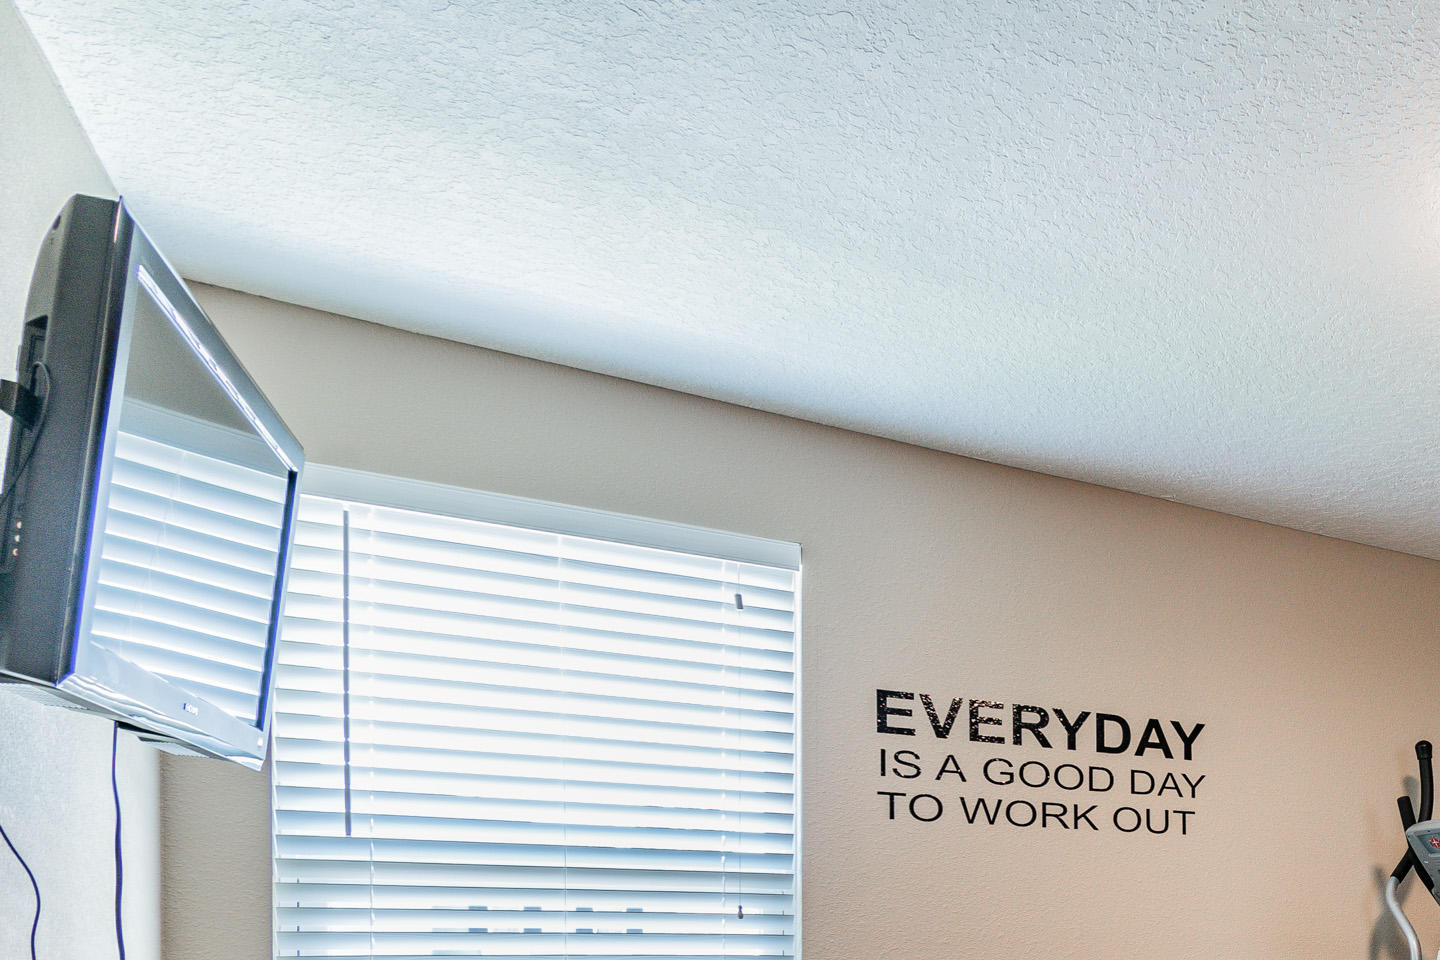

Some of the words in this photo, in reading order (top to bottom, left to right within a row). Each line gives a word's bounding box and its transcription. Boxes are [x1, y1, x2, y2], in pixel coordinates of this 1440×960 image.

[876, 688, 1206, 761] EVERYDAY
[880, 748, 922, 779] IS
[934, 754, 967, 783] A
[982, 757, 1115, 793] GOOD
[1130, 769, 1206, 799] DAY
[876, 791, 944, 823] TO
[959, 796, 1099, 831] WORK
[1112, 806, 1196, 836] OUT
